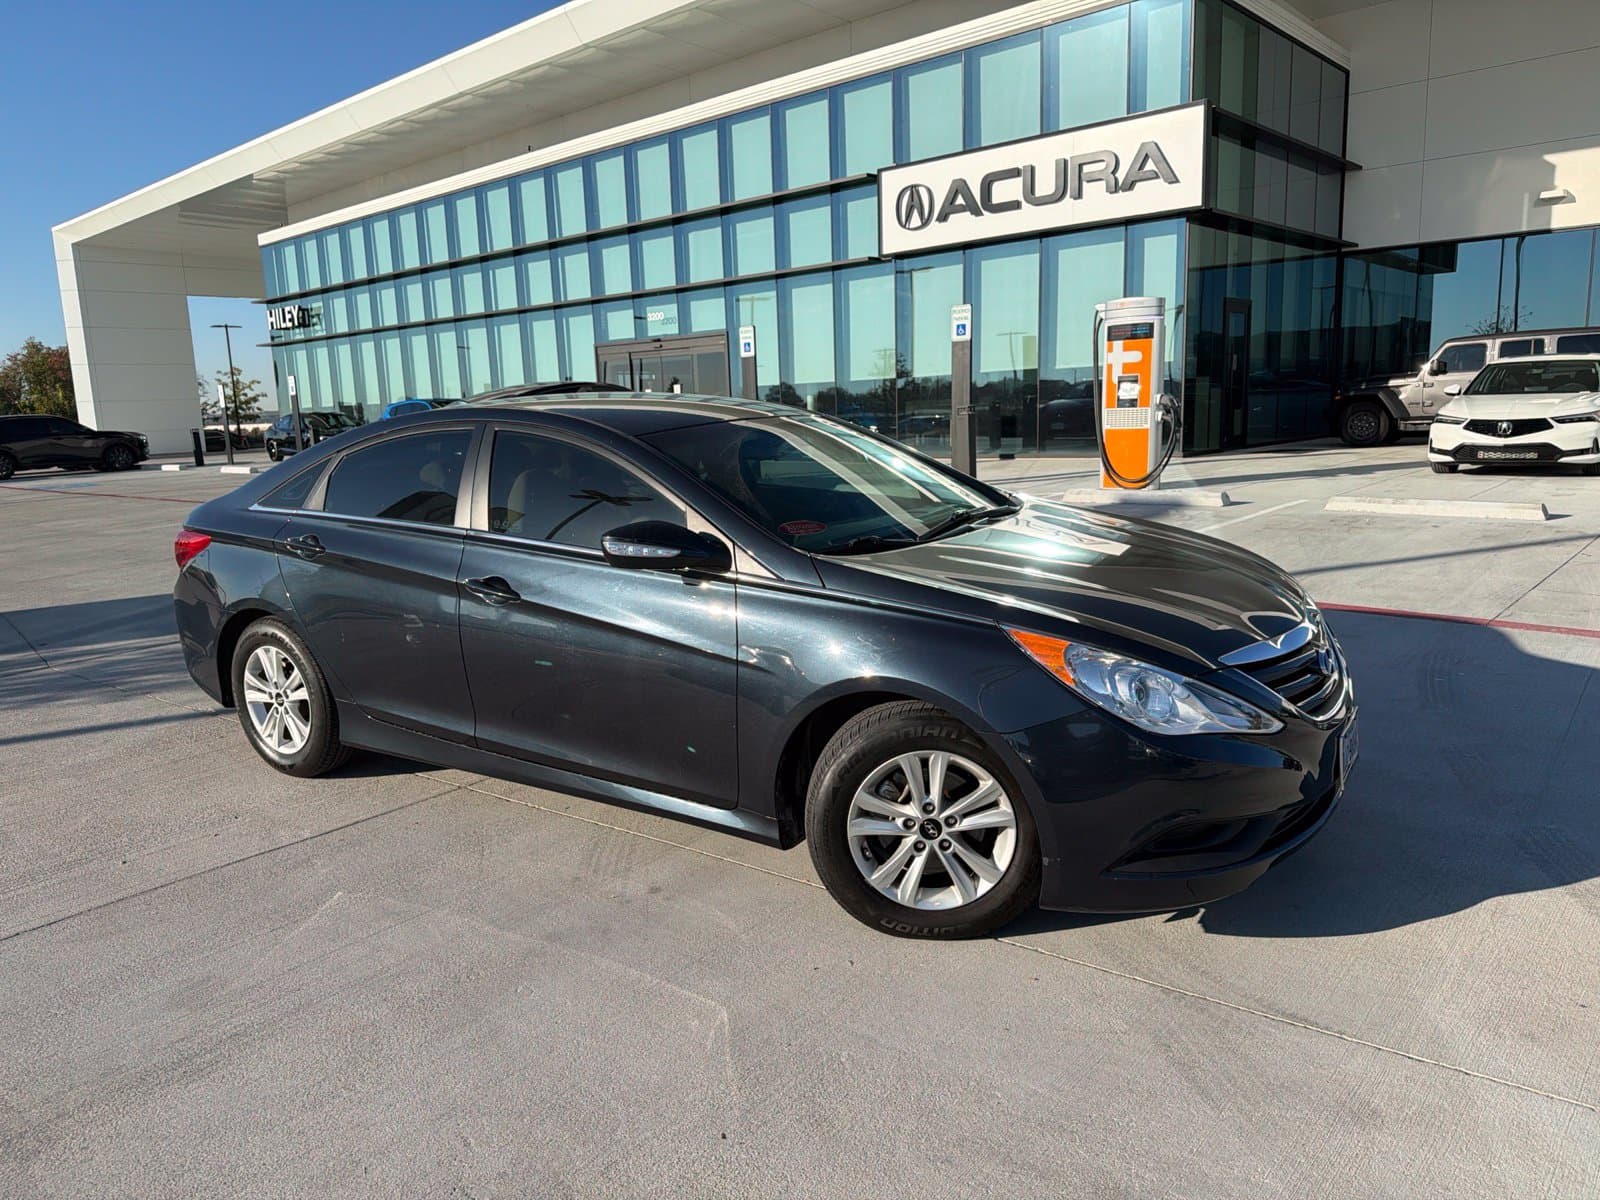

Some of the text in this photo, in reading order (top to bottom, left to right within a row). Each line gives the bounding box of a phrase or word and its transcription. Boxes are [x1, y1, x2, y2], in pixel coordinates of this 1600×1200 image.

[935, 140, 1181, 223] ACURA
[266, 304, 299, 330] HILEY
[647, 311, 664, 321] 3200
